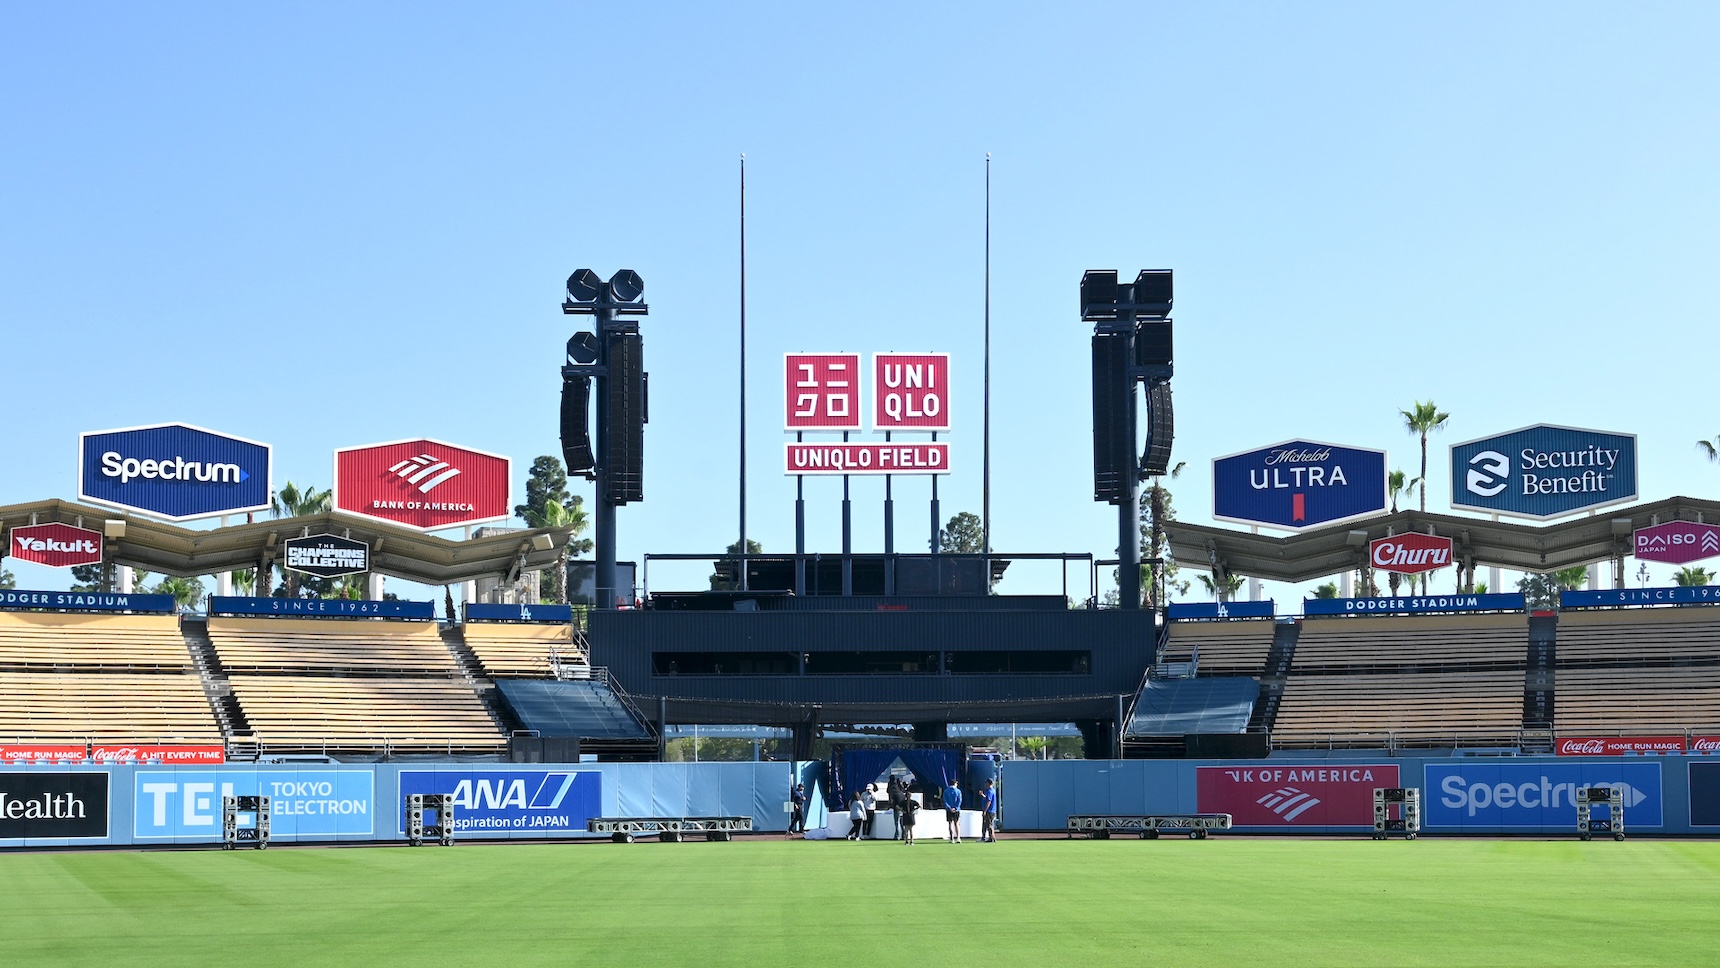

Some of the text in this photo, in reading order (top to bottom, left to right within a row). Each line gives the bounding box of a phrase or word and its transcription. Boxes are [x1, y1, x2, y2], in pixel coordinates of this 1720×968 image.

[884, 363, 935, 389] UNI
[884, 392, 940, 422] QLO
[794, 447, 941, 470] UNIQLO FIELD
[1264, 447, 1331, 465] Michelob
[1520, 444, 1620, 470] Security
[101, 451, 241, 484] Spectrum
[1250, 465, 1348, 490] ULTRA
[373, 500, 474, 512] BANK OF AMERICA
[15, 536, 98, 554] Yakult
[288, 546, 366, 559] CHAMPIONS
[1373, 542, 1449, 566] Churu
[288, 556, 366, 569] COLLECTIVE
[57, 594, 128, 607] STADIUM
[1346, 597, 1478, 610] DODGER STADIUM
[1619, 590, 1675, 601] SINCE
[272, 601, 379, 613] SINCE 1962
[520, 603, 532, 620] LA
[1217, 601, 1229, 618] LA
[1634, 742, 1652, 750] RUN
[1653, 742, 1681, 750] MAGIC
[5, 751, 33, 759] HOME
[34, 751, 53, 759] RUN
[141, 751, 149, 759] A
[149, 751, 166, 759] HIT
[167, 751, 197, 759] EVERY
[198, 751, 221, 759] TIME
[1259, 770, 1283, 783] OF
[1287, 769, 1374, 782] AMERICA
[271, 781, 332, 797] TOKYO
[453, 779, 527, 810] ANA
[273, 799, 367, 816] ELECTRON
[513, 816, 527, 827] of
[528, 815, 569, 828] JAPAN
